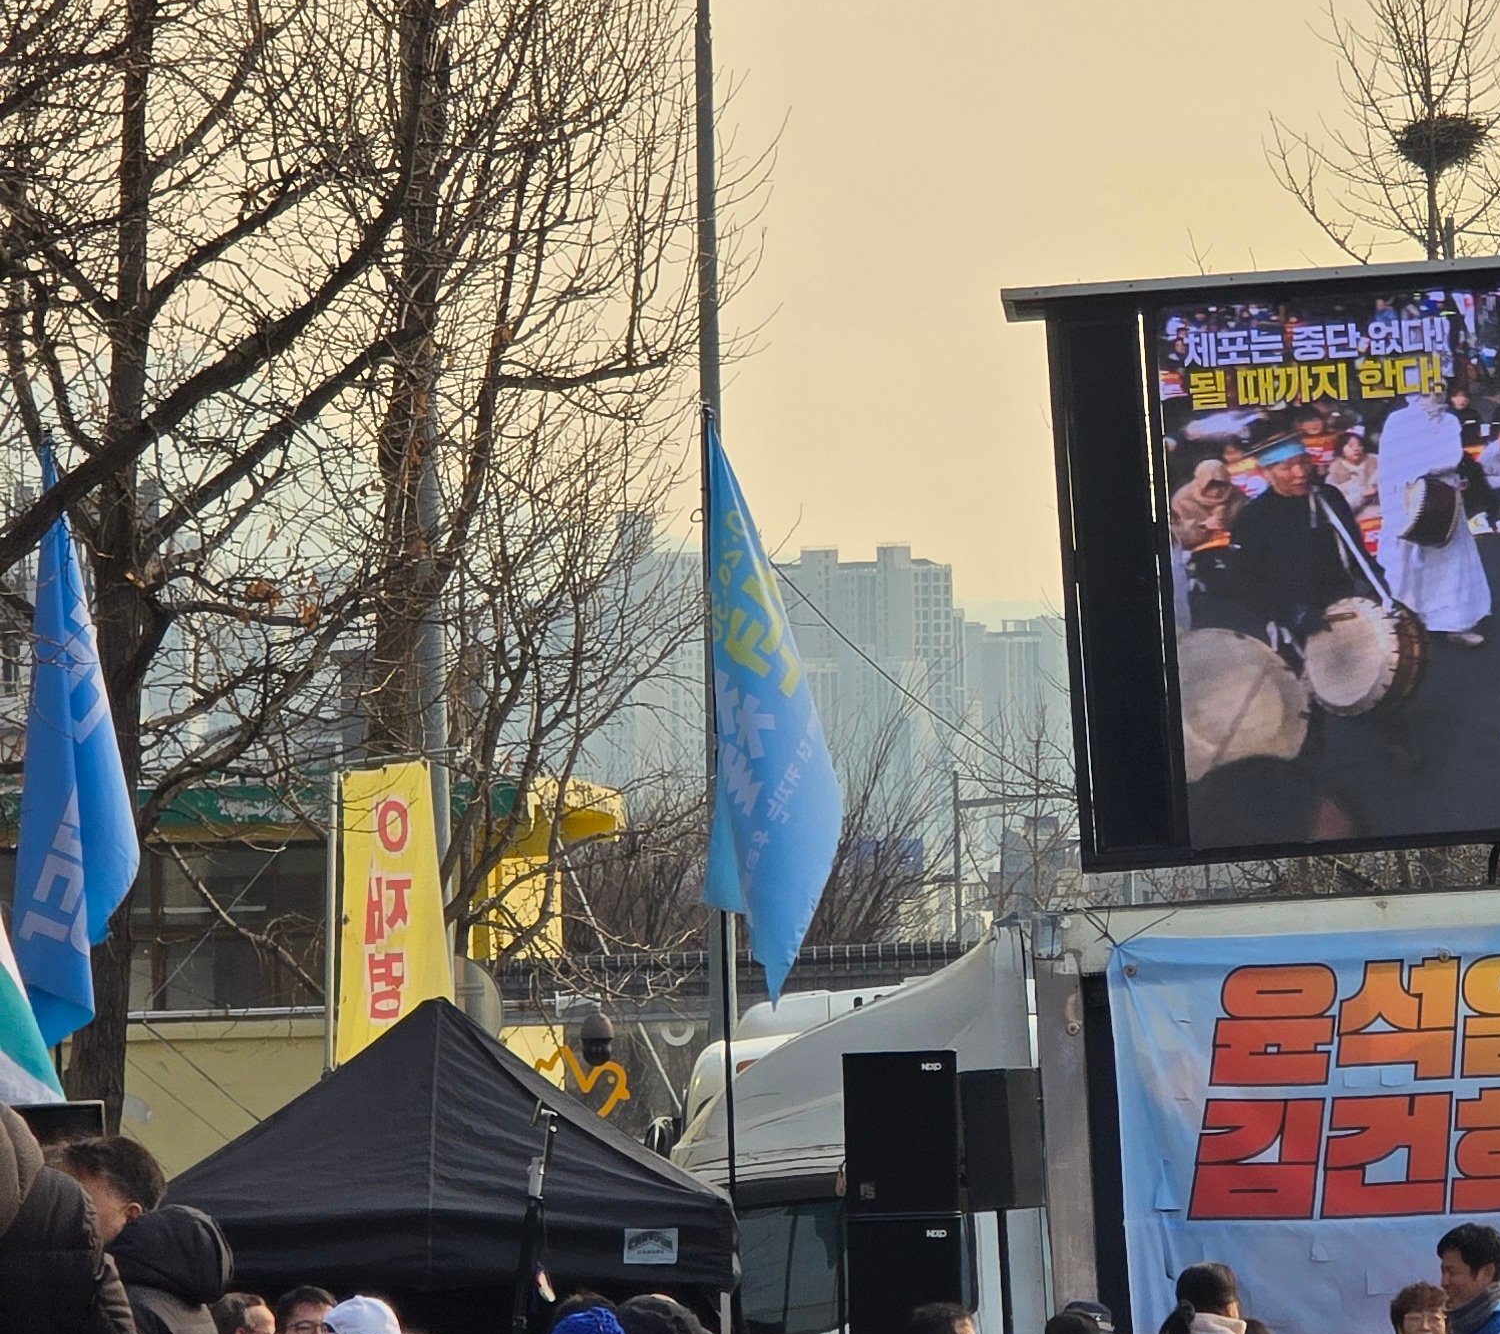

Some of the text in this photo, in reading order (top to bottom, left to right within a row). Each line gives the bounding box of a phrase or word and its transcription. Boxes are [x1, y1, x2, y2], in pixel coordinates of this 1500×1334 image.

[1184, 317, 1446, 368] 체포는 중단 없다!
[1190, 354, 1443, 410] 될 때까지 한다!
